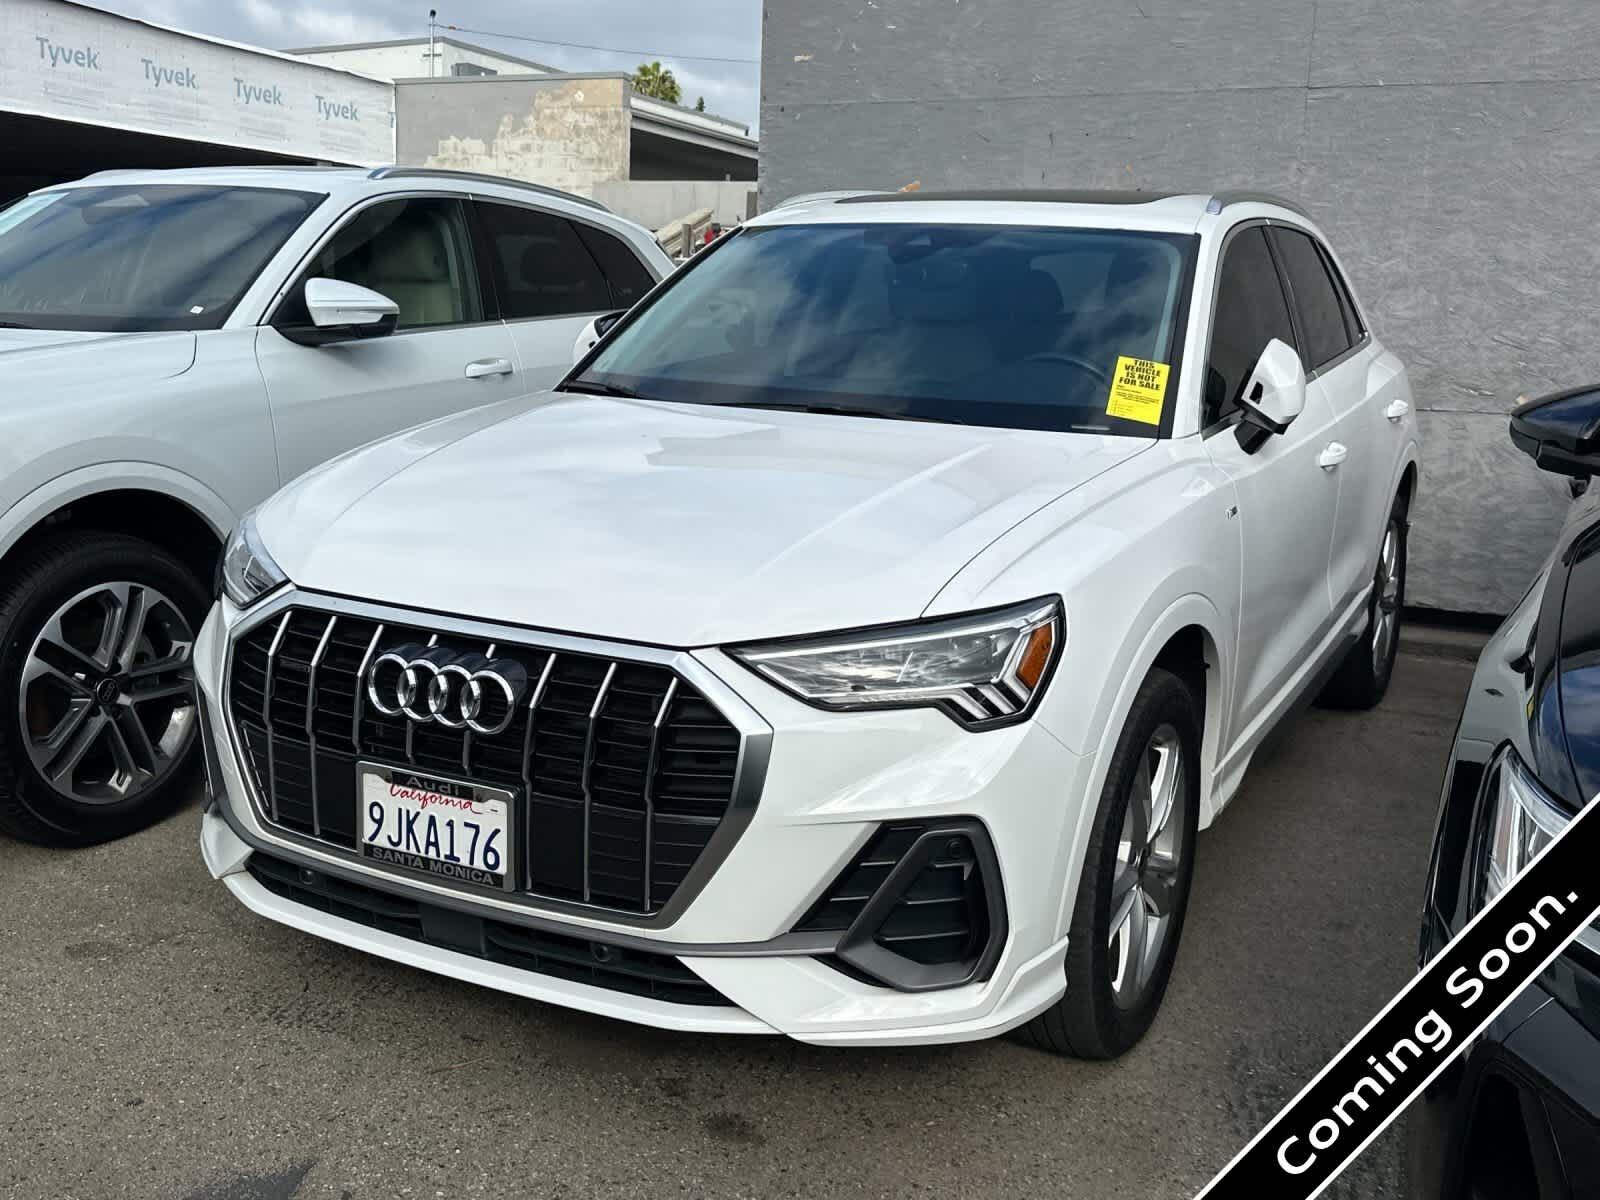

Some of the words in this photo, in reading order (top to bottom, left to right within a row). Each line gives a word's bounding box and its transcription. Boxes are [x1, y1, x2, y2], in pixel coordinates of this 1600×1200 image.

[36, 36, 99, 70] Tyvek
[141, 58, 197, 89] Tyvek
[233, 77, 282, 106] Tyvek
[315, 95, 359, 121] Tyvek
[1125, 364, 1160, 377] VEHICLE
[1134, 360, 1154, 368] THIS
[1119, 377, 1136, 385] FOR
[1139, 381, 1160, 390] SALE
[1138, 374, 1155, 382] NOT
[407, 776, 460, 796] Audi
[367, 801, 502, 872] 9JKA176
[373, 848, 425, 869] SANTA
[429, 860, 495, 886] MONICA
